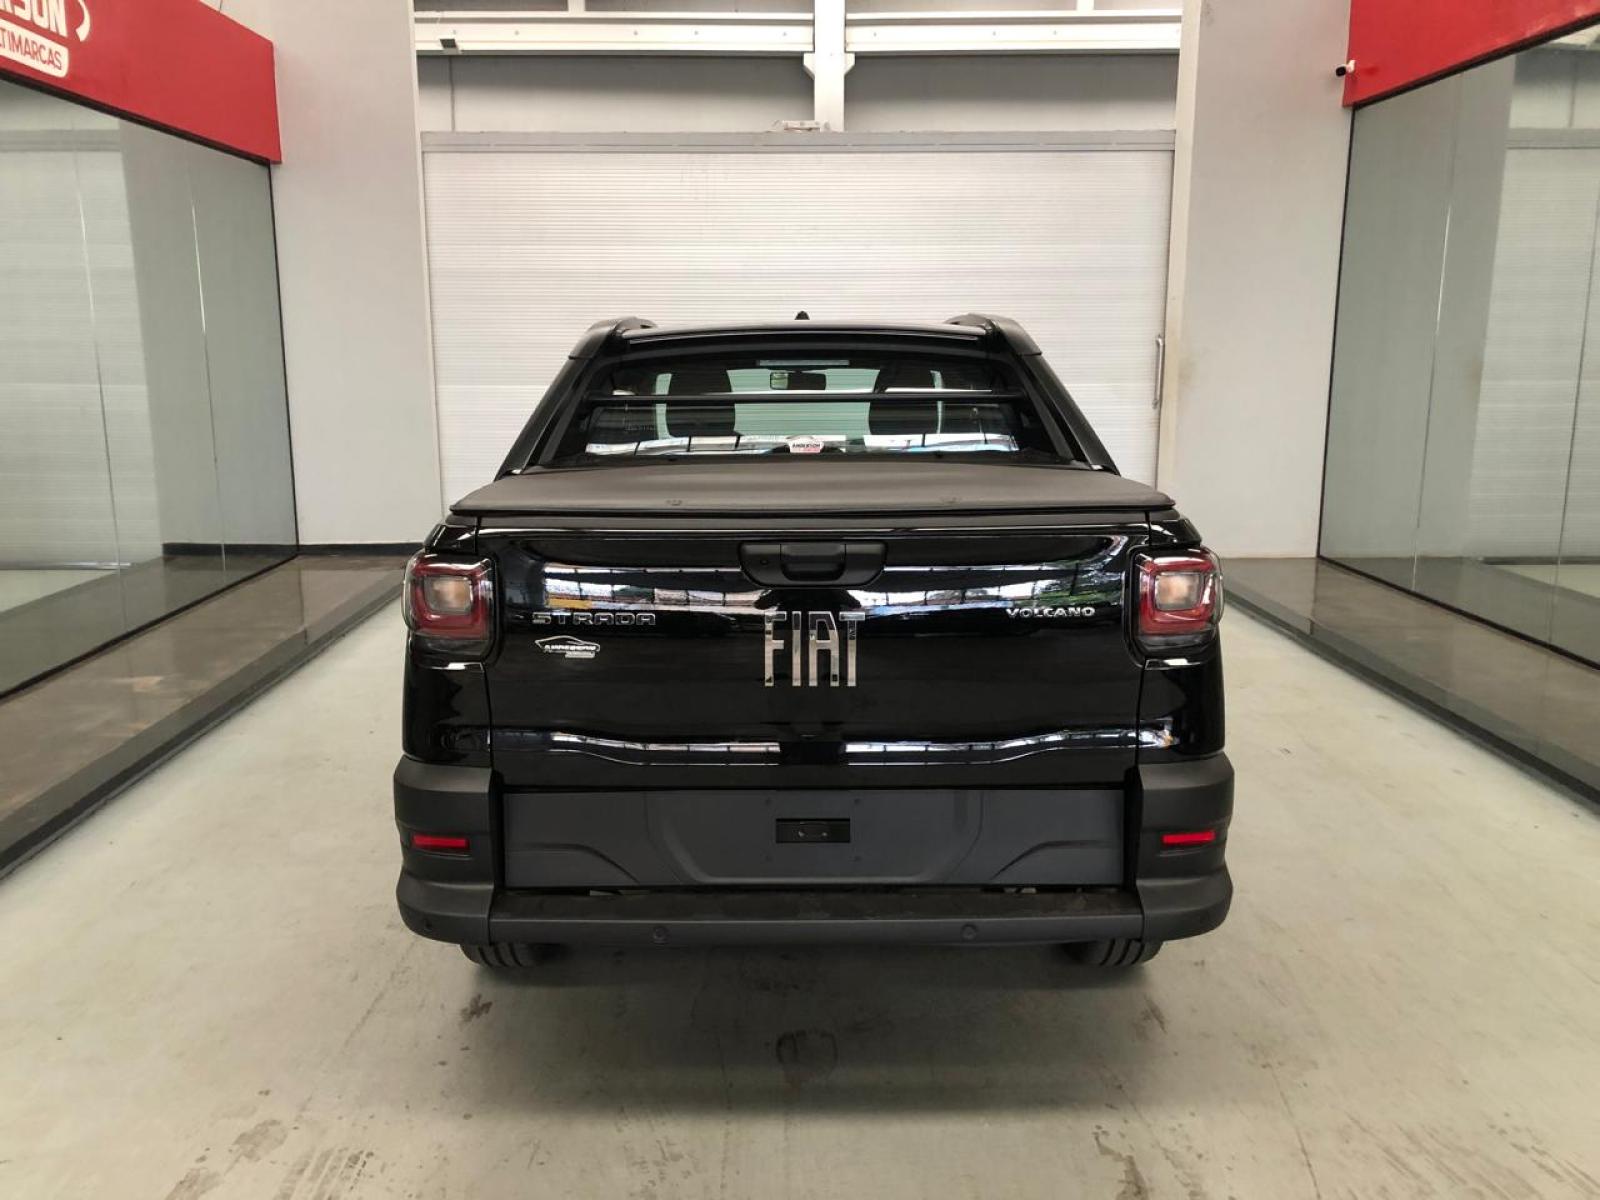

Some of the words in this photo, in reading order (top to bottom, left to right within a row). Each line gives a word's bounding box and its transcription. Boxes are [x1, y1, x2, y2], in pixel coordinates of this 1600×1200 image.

[0, 26, 62, 71] TIMARCAS
[532, 611, 656, 626] STRADA
[1005, 606, 1096, 618] VOLCANO
[764, 610, 866, 687] FIAT
